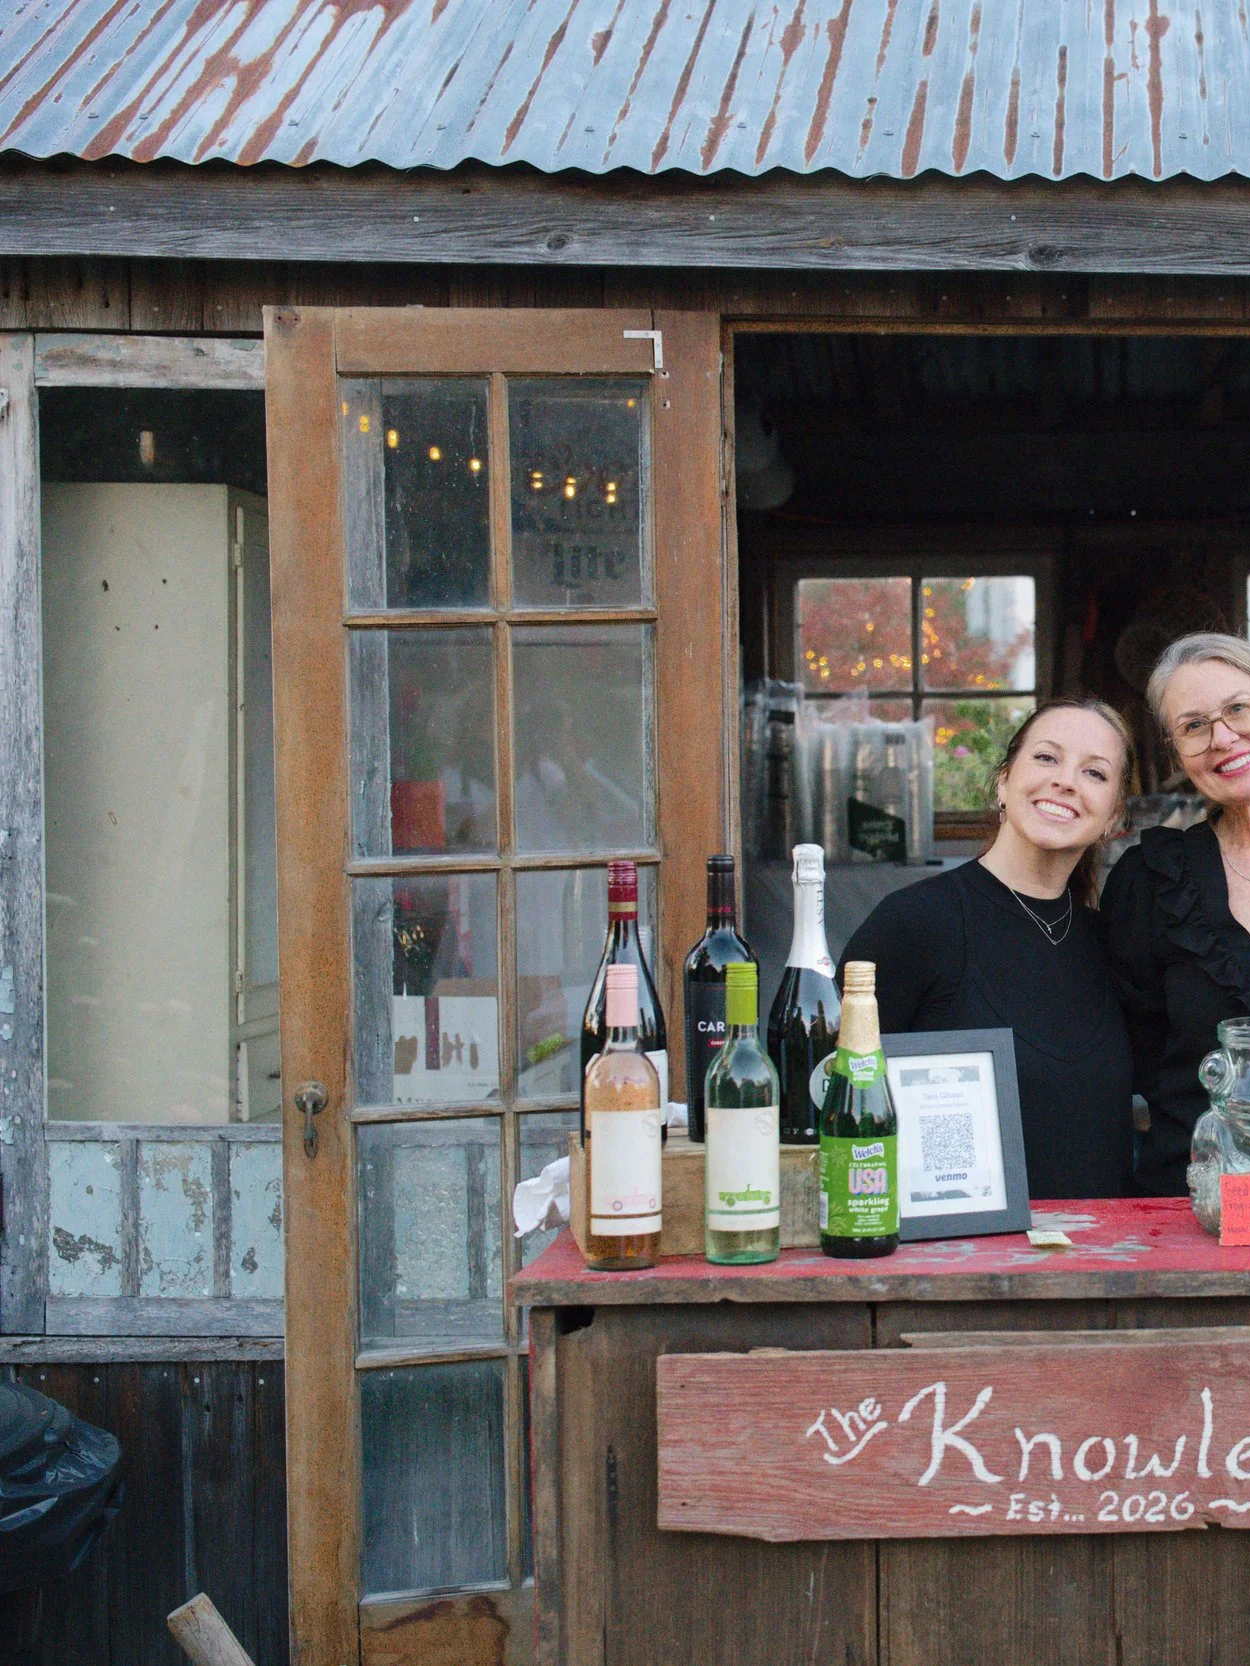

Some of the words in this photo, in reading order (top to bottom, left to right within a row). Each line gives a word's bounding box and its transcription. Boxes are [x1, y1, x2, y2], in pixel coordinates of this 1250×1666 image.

[854, 1144, 884, 1160] Welch's
[849, 1168, 888, 1196] USA
[935, 1172, 968, 1182] venmo
[848, 1198, 889, 1208] sparkling
[806, 1396, 883, 1452] The
[1098, 1490, 1195, 1523] 2026
